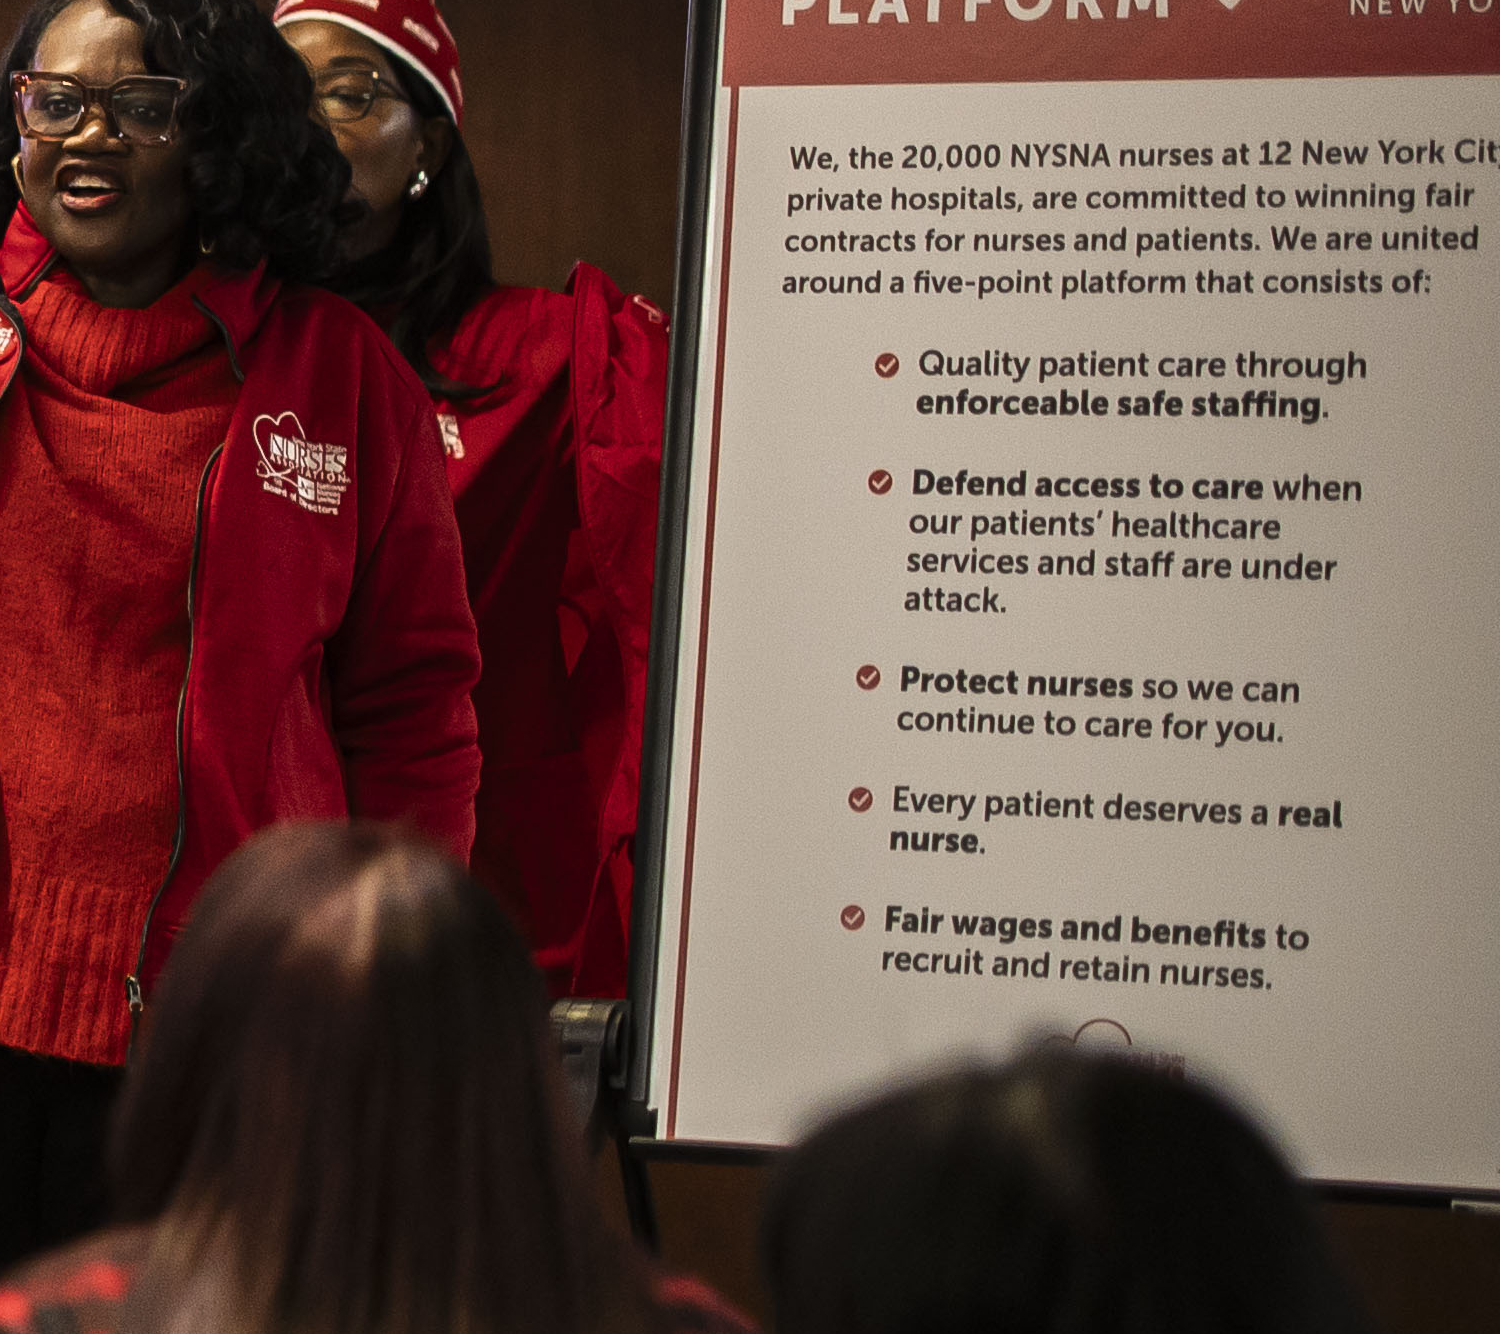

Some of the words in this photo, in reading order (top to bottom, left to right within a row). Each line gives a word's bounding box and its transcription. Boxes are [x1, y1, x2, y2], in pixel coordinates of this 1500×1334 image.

[790, 146, 839, 173] We,
[848, 145, 894, 170] the
[901, 144, 1001, 172] 20,000
[1010, 143, 1111, 168] NYSNA
[1119, 147, 1214, 167] nurses
[1259, 140, 1292, 166] 12
[1302, 140, 1369, 166] New
[1378, 139, 1445, 165] York
[787, 187, 883, 217] private
[891, 185, 1023, 217] hospitals,
[1032, 191, 1078, 210] are
[1085, 183, 1246, 210] committed
[1295, 182, 1416, 214] winning
[1425, 182, 1475, 208] fair
[784, 230, 916, 253] contracts
[925, 228, 966, 252] for
[973, 233, 1066, 252] nurses
[1073, 226, 1127, 252] and
[1136, 226, 1260, 258] patients.
[1325, 231, 1373, 251] are
[1382, 224, 1479, 251] united
[782, 269, 882, 294] around
[913, 269, 1053, 300] five-point
[1061, 269, 1186, 300] platform
[1195, 269, 1254, 294] that
[1262, 268, 1383, 294] consists
[1391, 268, 1431, 294] of:
[919, 349, 1031, 384] Quality
[1039, 350, 1149, 384] patient
[1158, 357, 1226, 378] care
[1235, 350, 1367, 386] through
[916, 388, 1109, 416] enforceable
[1117, 389, 1184, 417] safe
[1192, 390, 1329, 425] staffing.
[270, 433, 347, 473] NURSES
[912, 468, 1027, 497] Defend
[1035, 477, 1141, 499] access
[1192, 479, 1264, 500] care
[1273, 473, 1362, 502] when
[909, 514, 963, 535] our
[970, 509, 1103, 542] patients'
[1112, 510, 1281, 540] healthcare
[907, 547, 1029, 575] services
[1037, 549, 1096, 576] and
[1104, 550, 1175, 578] staff
[1181, 557, 1232, 579] are
[1241, 552, 1338, 581] under
[904, 586, 1006, 613] attack.
[900, 665, 1019, 695] Protect
[1027, 675, 1133, 699] nurses
[1242, 681, 1300, 704] can
[897, 706, 1035, 735] continue
[1084, 716, 1153, 739] care
[1162, 712, 1208, 740] for
[1214, 720, 1283, 748] you.
[893, 785, 977, 822] Every
[984, 790, 1095, 822] patient
[1103, 793, 1242, 825] deserves
[1278, 800, 1343, 829] real
[889, 831, 985, 854] nurse.
[885, 905, 944, 934] Fair
[951, 915, 1053, 943] wages
[1060, 915, 1122, 942] and
[1131, 915, 1266, 949] benefits
[882, 948, 984, 976] recruit
[991, 951, 1050, 979] and
[1059, 955, 1150, 984] retain
[1160, 964, 1272, 990] nurses.
